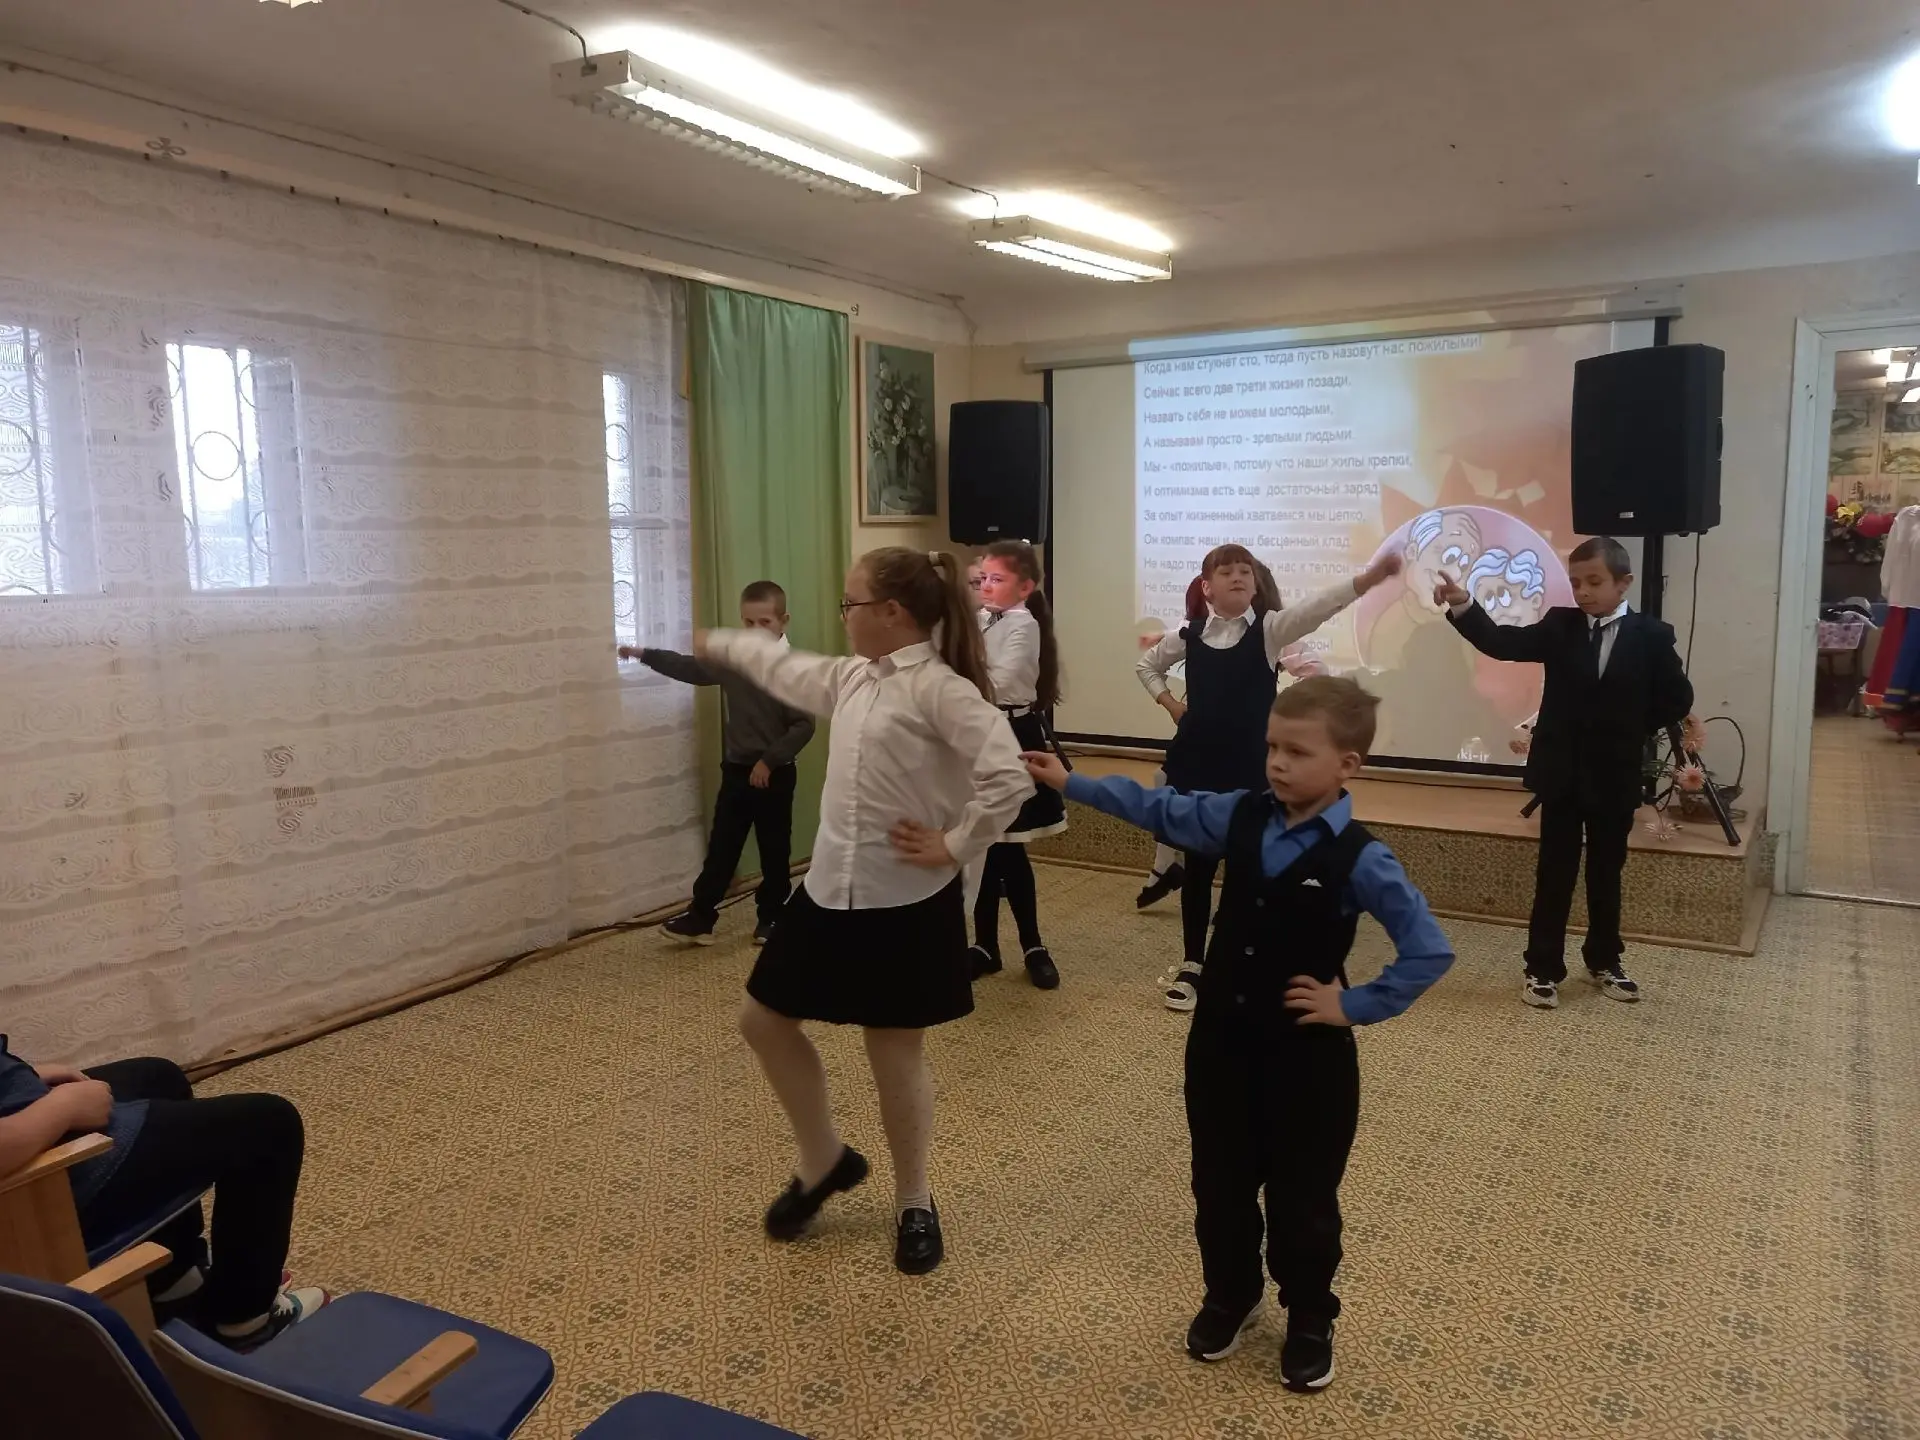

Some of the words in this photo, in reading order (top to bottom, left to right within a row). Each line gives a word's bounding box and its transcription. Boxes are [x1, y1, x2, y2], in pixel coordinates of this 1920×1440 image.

[1264, 352, 1294, 366] тогда
[1297, 350, 1330, 365] пусть
[1333, 345, 1379, 360] назовут
[1383, 344, 1404, 356] нас
[1144, 386, 1180, 399] Сейчас
[1184, 385, 1211, 397] всего
[1213, 383, 1234, 397] две
[1187, 408, 1211, 421] себя
[1214, 409, 1226, 420] не
[1143, 436, 1151, 448] А
[1207, 434, 1242, 449] просто
[1234, 459, 1272, 472] потому
[1275, 458, 1294, 469] что
[1298, 457, 1328, 469] наши
[1266, 482, 1339, 497] достаточный
